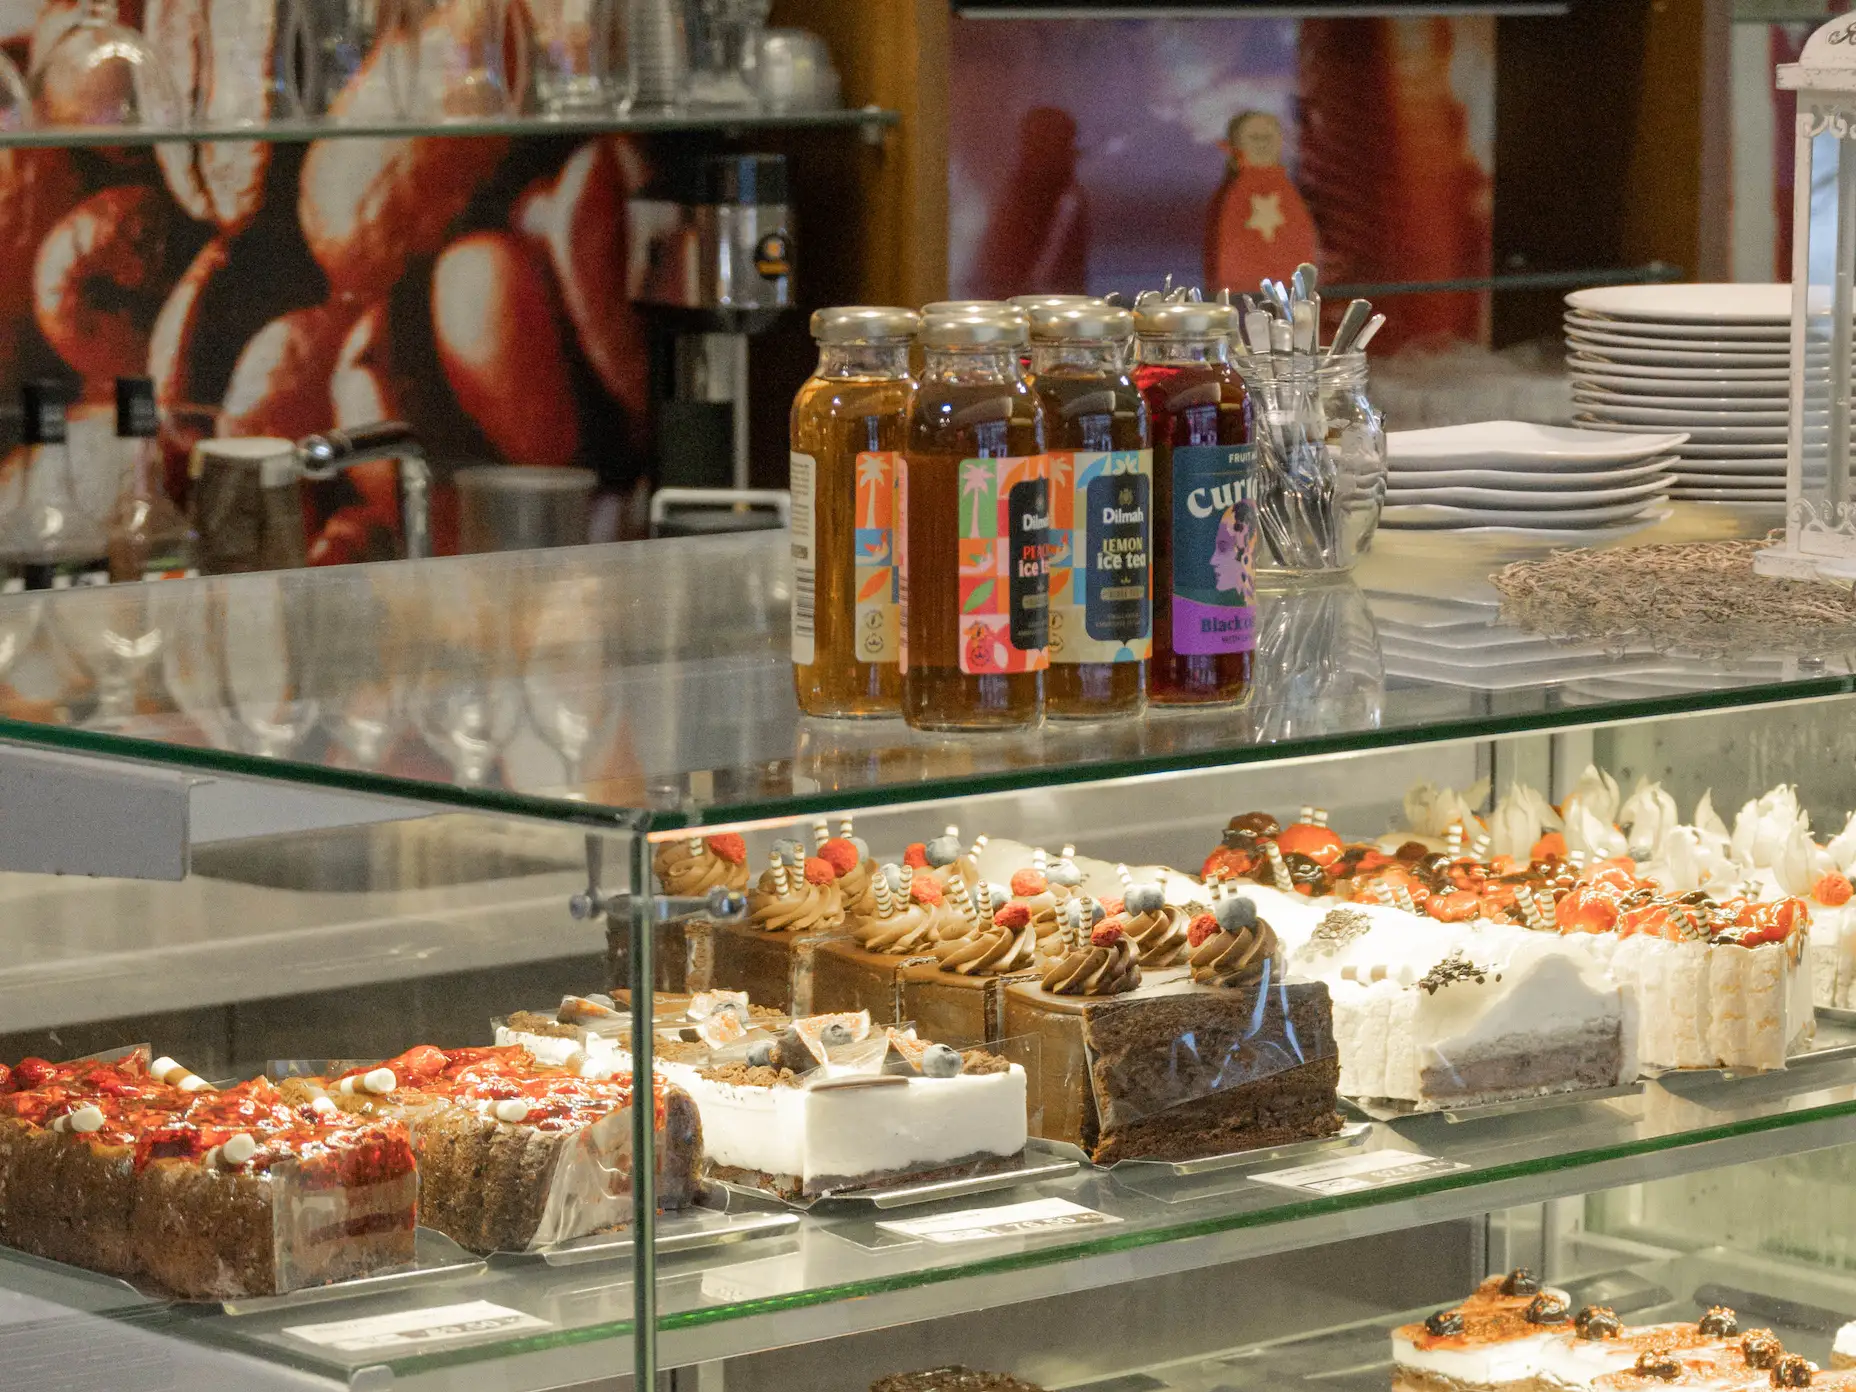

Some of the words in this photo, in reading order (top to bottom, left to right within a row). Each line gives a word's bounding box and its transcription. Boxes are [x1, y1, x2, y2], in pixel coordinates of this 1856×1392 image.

[1103, 507, 1144, 524] Dilmah
[1103, 537, 1143, 552] LEMON
[1018, 559, 1038, 577] ice
[1097, 552, 1122, 570] ice
[1125, 552, 1146, 568] tea
[1201, 615, 1241, 632] Black
